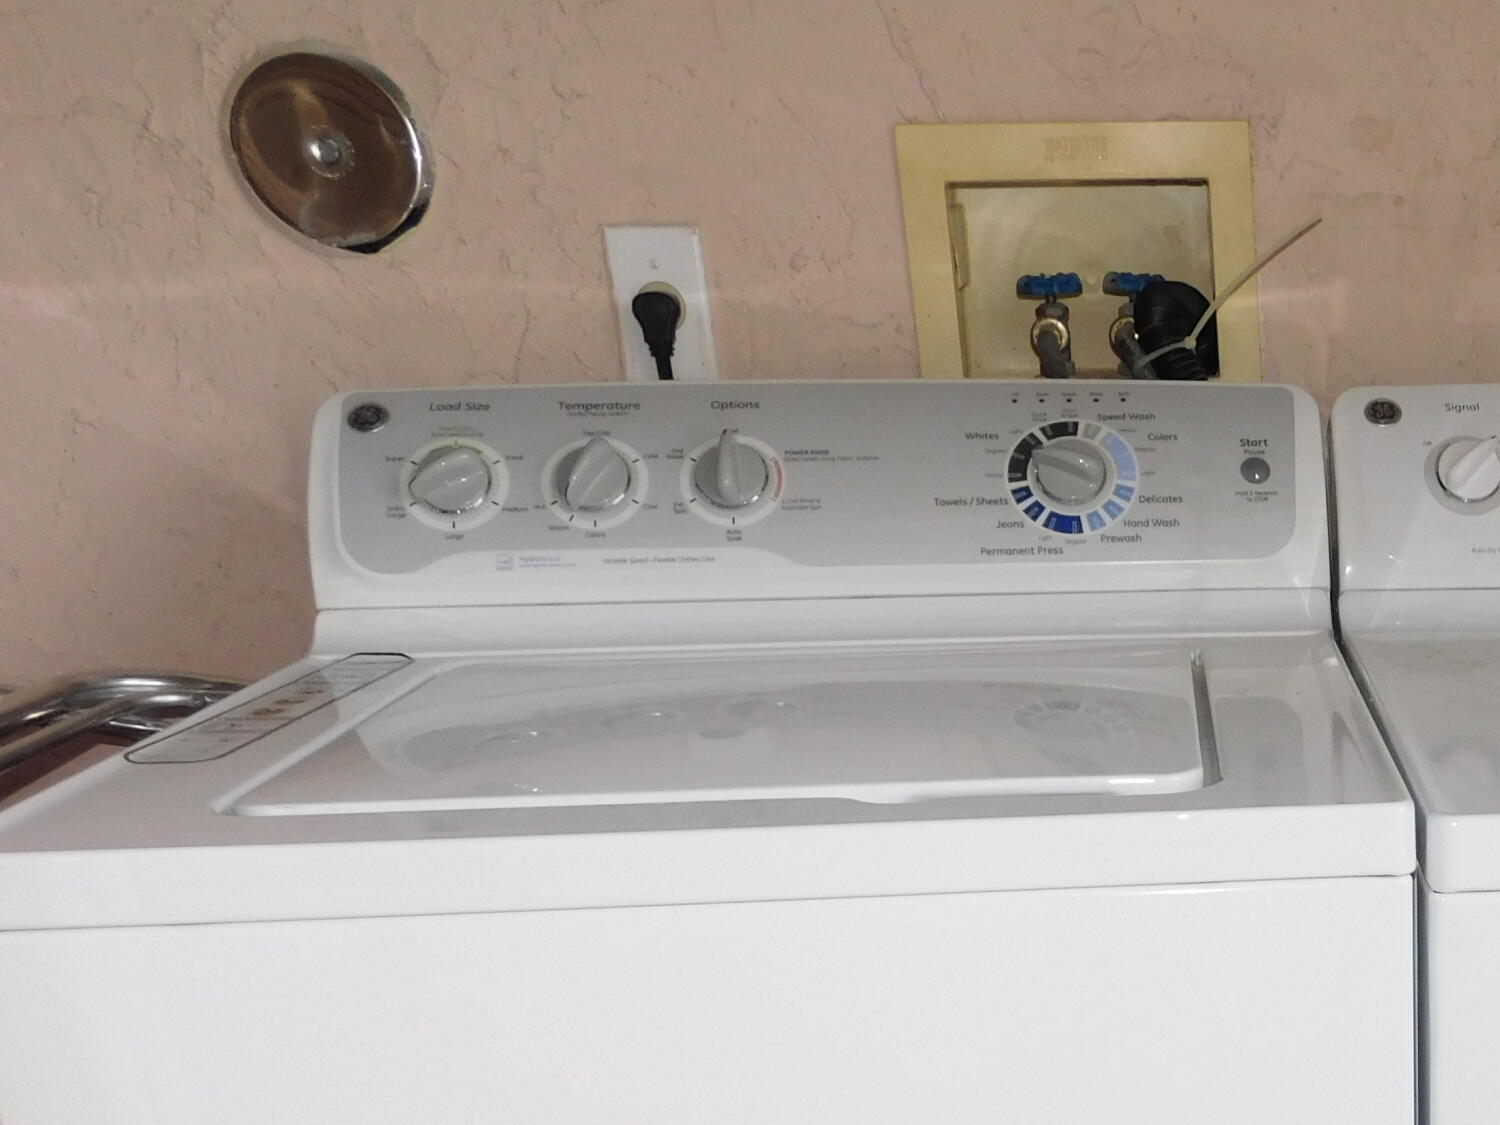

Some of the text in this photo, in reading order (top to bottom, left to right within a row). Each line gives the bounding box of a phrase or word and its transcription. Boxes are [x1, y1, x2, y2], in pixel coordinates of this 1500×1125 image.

[429, 401, 491, 412] Load Size
[558, 401, 641, 413] Temperature
[710, 400, 760, 411] Options
[1444, 402, 1480, 413] Signal
[1096, 412, 1156, 423] Speed Wash
[964, 432, 1000, 441] Whites
[1147, 432, 1178, 441] Colors
[1239, 438, 1269, 448] Start
[934, 496, 1009, 507] Towels / Sheets
[1138, 494, 1184, 504] Delicates
[996, 520, 1025, 529] Jeans
[1123, 517, 1180, 528] Hand Wash
[1100, 533, 1142, 543] Prewash
[980, 545, 1064, 556] Permanent Press
